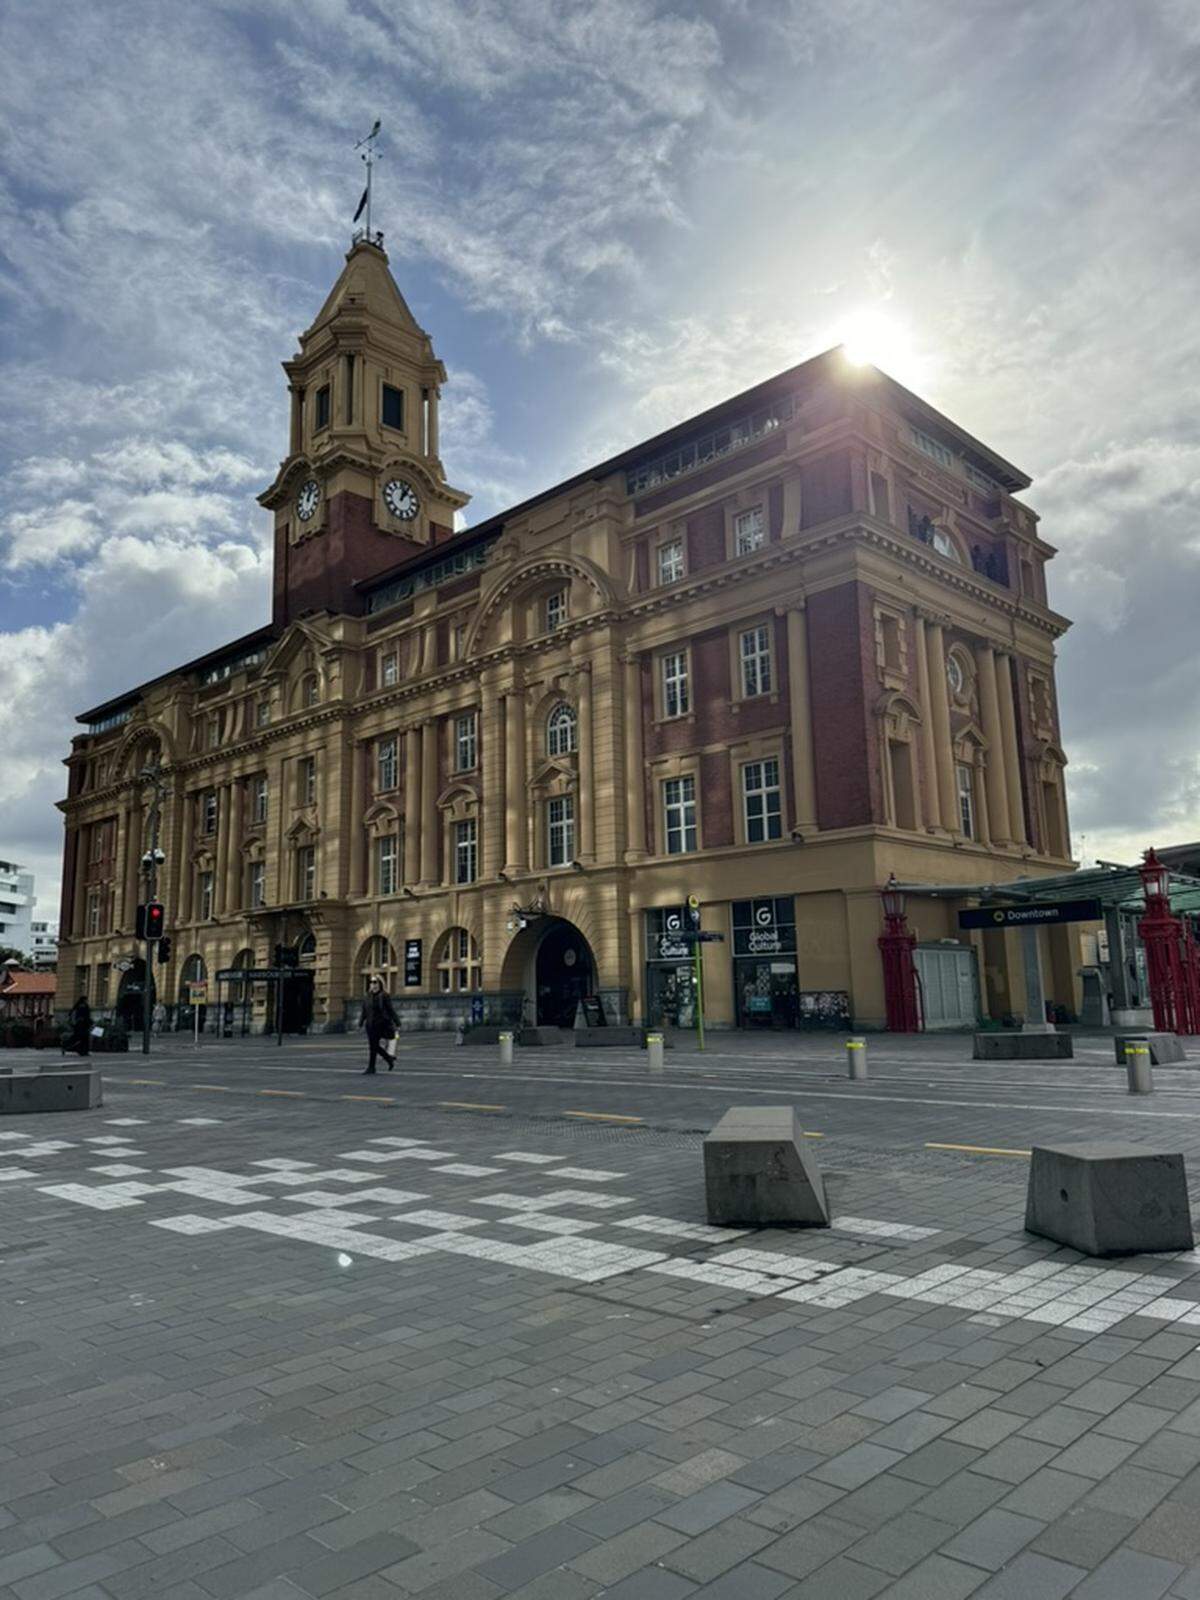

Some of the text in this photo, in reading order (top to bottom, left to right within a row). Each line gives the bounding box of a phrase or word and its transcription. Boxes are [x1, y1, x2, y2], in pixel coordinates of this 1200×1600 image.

[756, 907, 771, 925] G
[1008, 909, 1059, 920] Downtown
[667, 914, 680, 931] G
[749, 931, 778, 943] Global
[749, 942, 781, 952] Culture
